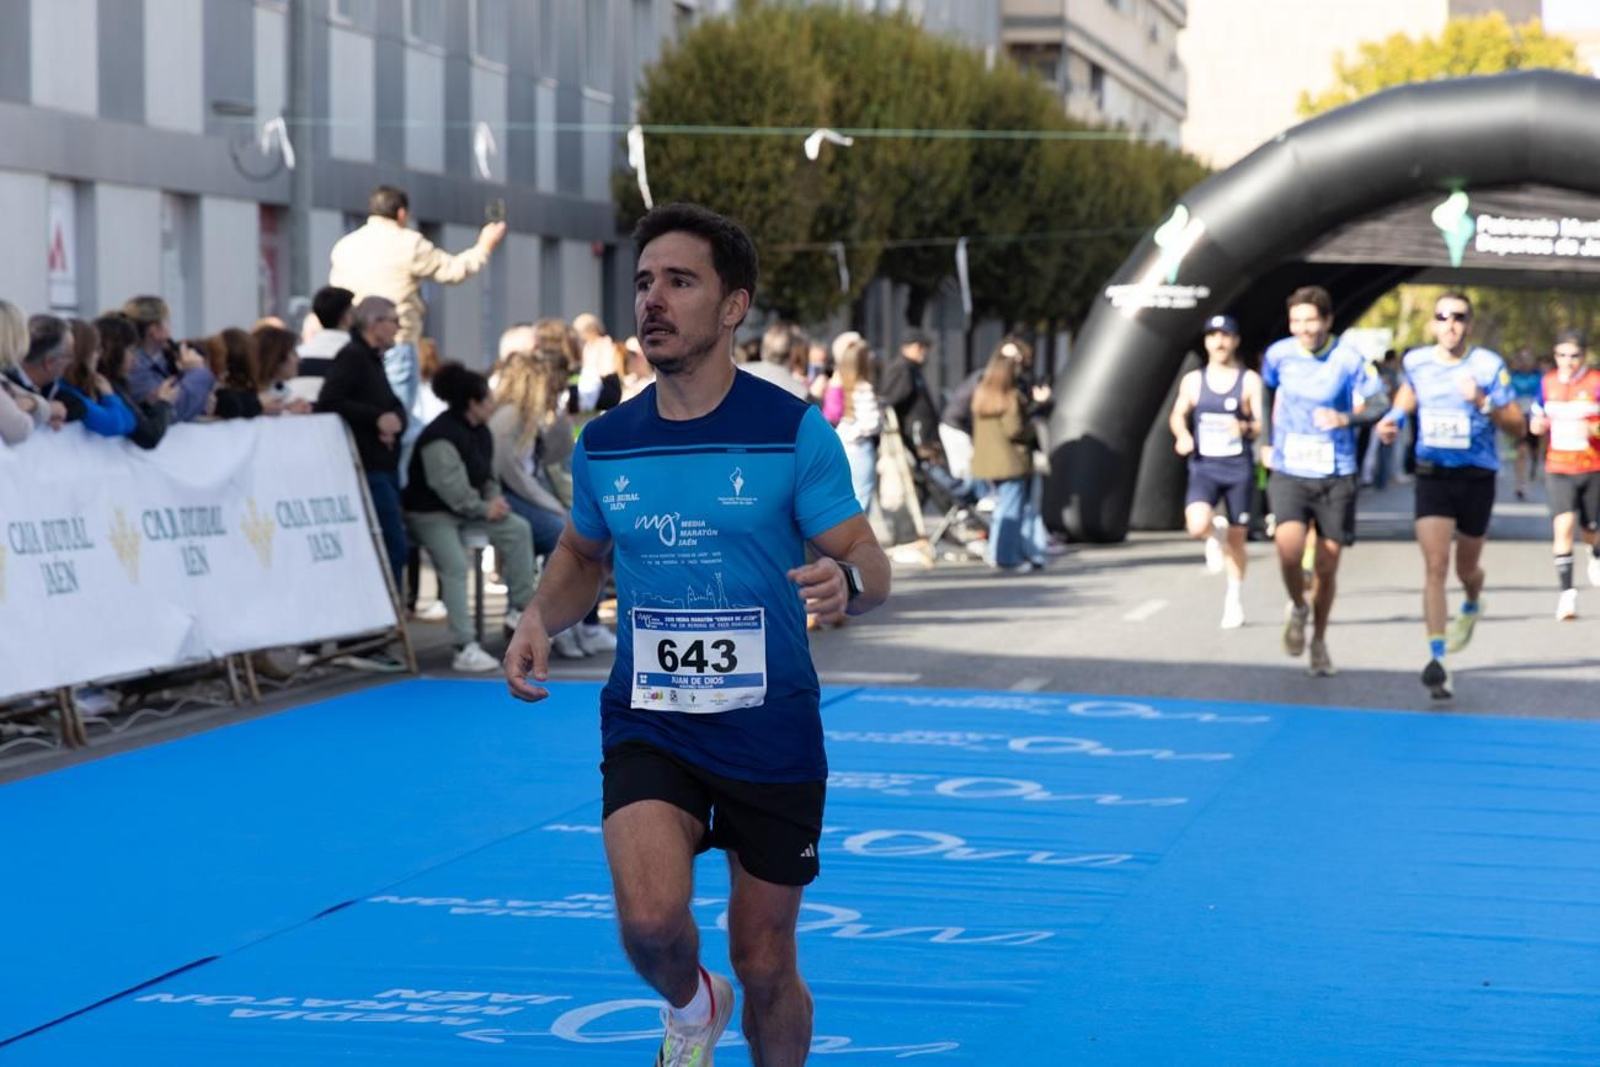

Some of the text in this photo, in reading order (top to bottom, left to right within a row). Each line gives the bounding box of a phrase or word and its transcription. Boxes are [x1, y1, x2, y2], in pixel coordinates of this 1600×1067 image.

[680, 520, 706, 528] MEDIA
[679, 528, 718, 537] MARATÓN
[678, 538, 698, 546] JAÉN
[657, 639, 738, 673] 643
[671, 675, 725, 685] JUAN DE DIOS
[229, 1008, 484, 1026] MEDIA
